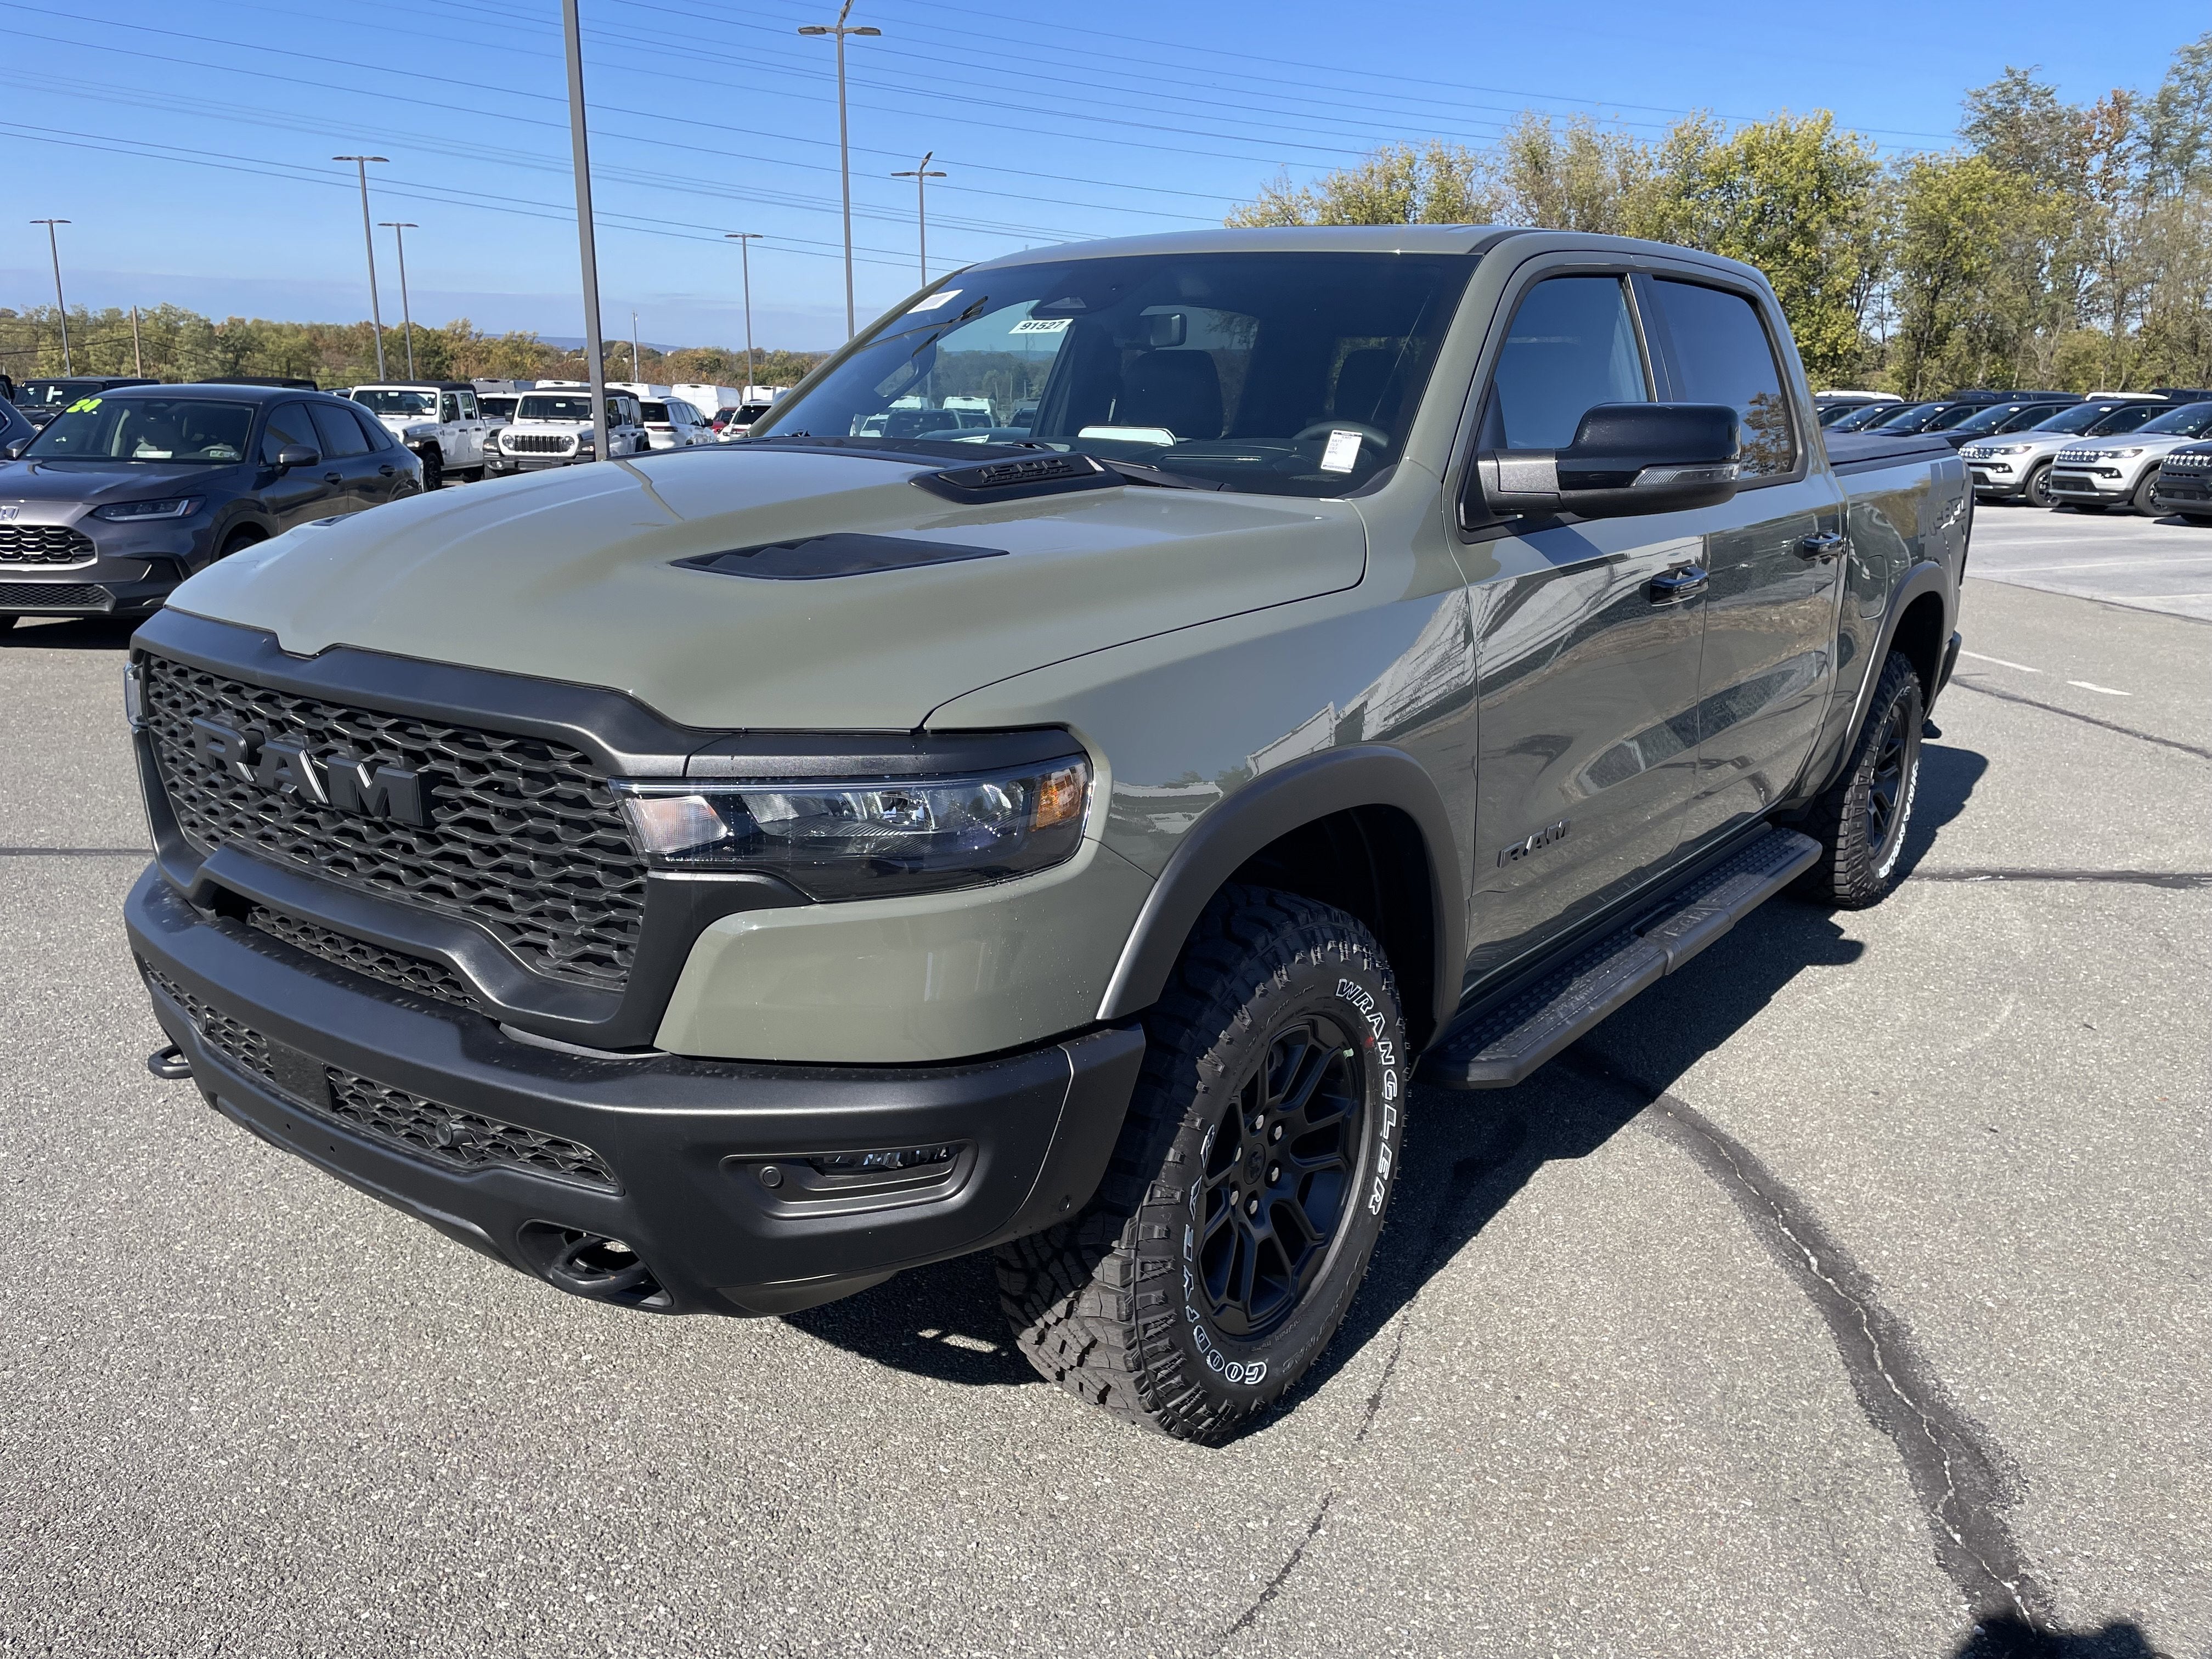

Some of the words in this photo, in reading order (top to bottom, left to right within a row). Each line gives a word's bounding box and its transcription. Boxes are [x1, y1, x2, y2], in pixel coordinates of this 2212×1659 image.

[1020, 321, 1065, 330] 91527
[976, 458, 1070, 478] 1500
[193, 716, 422, 826] RAM
[1497, 818, 1571, 868] RAM
[1335, 978, 1397, 1215] WRANGLER
